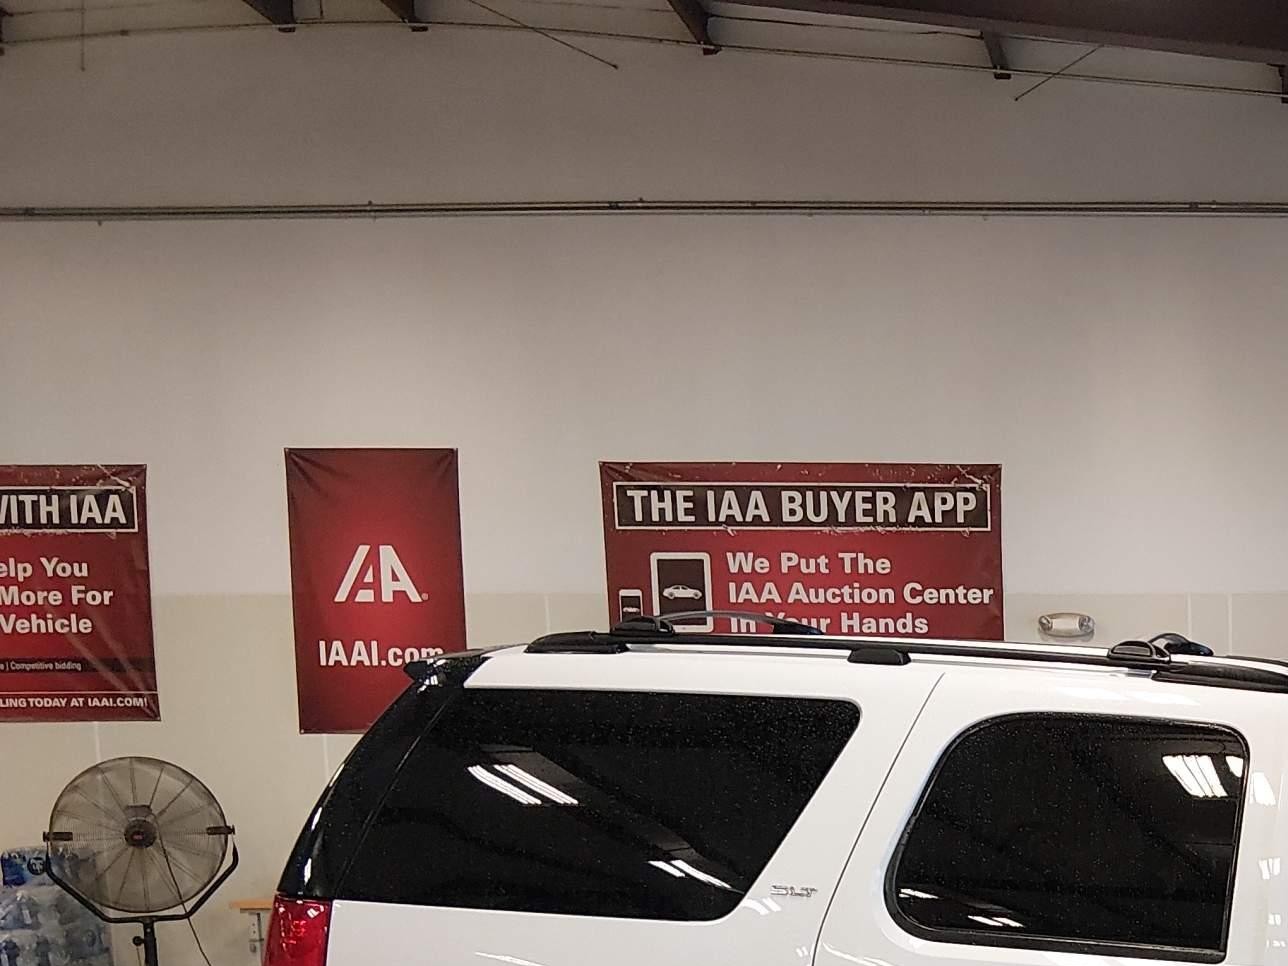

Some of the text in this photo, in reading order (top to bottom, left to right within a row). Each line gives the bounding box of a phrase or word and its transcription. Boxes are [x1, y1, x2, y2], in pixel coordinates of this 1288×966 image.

[69, 494, 127, 524] IAA
[626, 489, 977, 524] THE IAA BUYER APP
[39, 557, 89, 578] You
[726, 551, 891, 575] We Put The
[0, 585, 114, 606] More For
[728, 581, 994, 605] IAA Auction Center
[0, 613, 93, 634] Vehicle
[730, 612, 929, 634] In ur Hands
[10, 661, 54, 672] Competitive
[54, 661, 82, 672] bidding
[27, 697, 68, 708] TODAY
[70, 697, 85, 708] AT
[88, 697, 148, 708] IAAI.COM!
